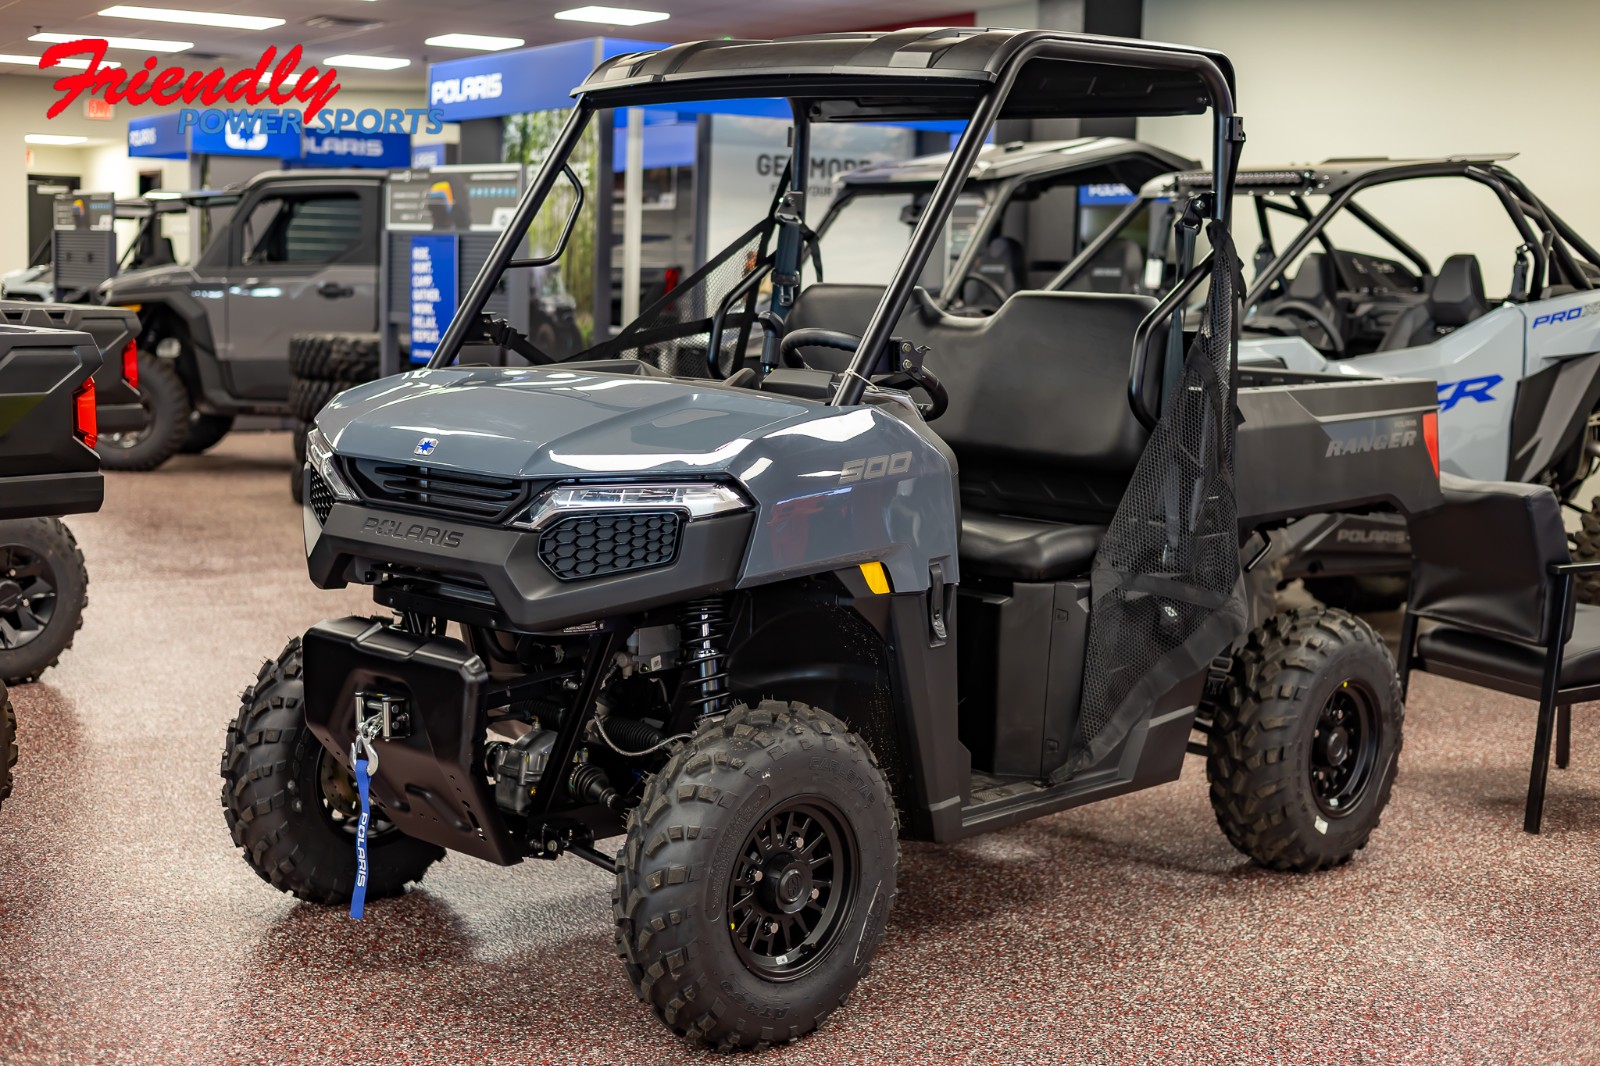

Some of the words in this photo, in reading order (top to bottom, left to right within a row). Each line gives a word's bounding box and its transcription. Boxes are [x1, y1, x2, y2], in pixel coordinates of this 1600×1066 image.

[431, 73, 502, 105] POLARIS
[757, 154, 789, 176] GE
[1325, 430, 1417, 459] RANGER
[838, 451, 912, 486] 500
[361, 516, 464, 549] POLARIS
[357, 812, 368, 887] POLARIS
